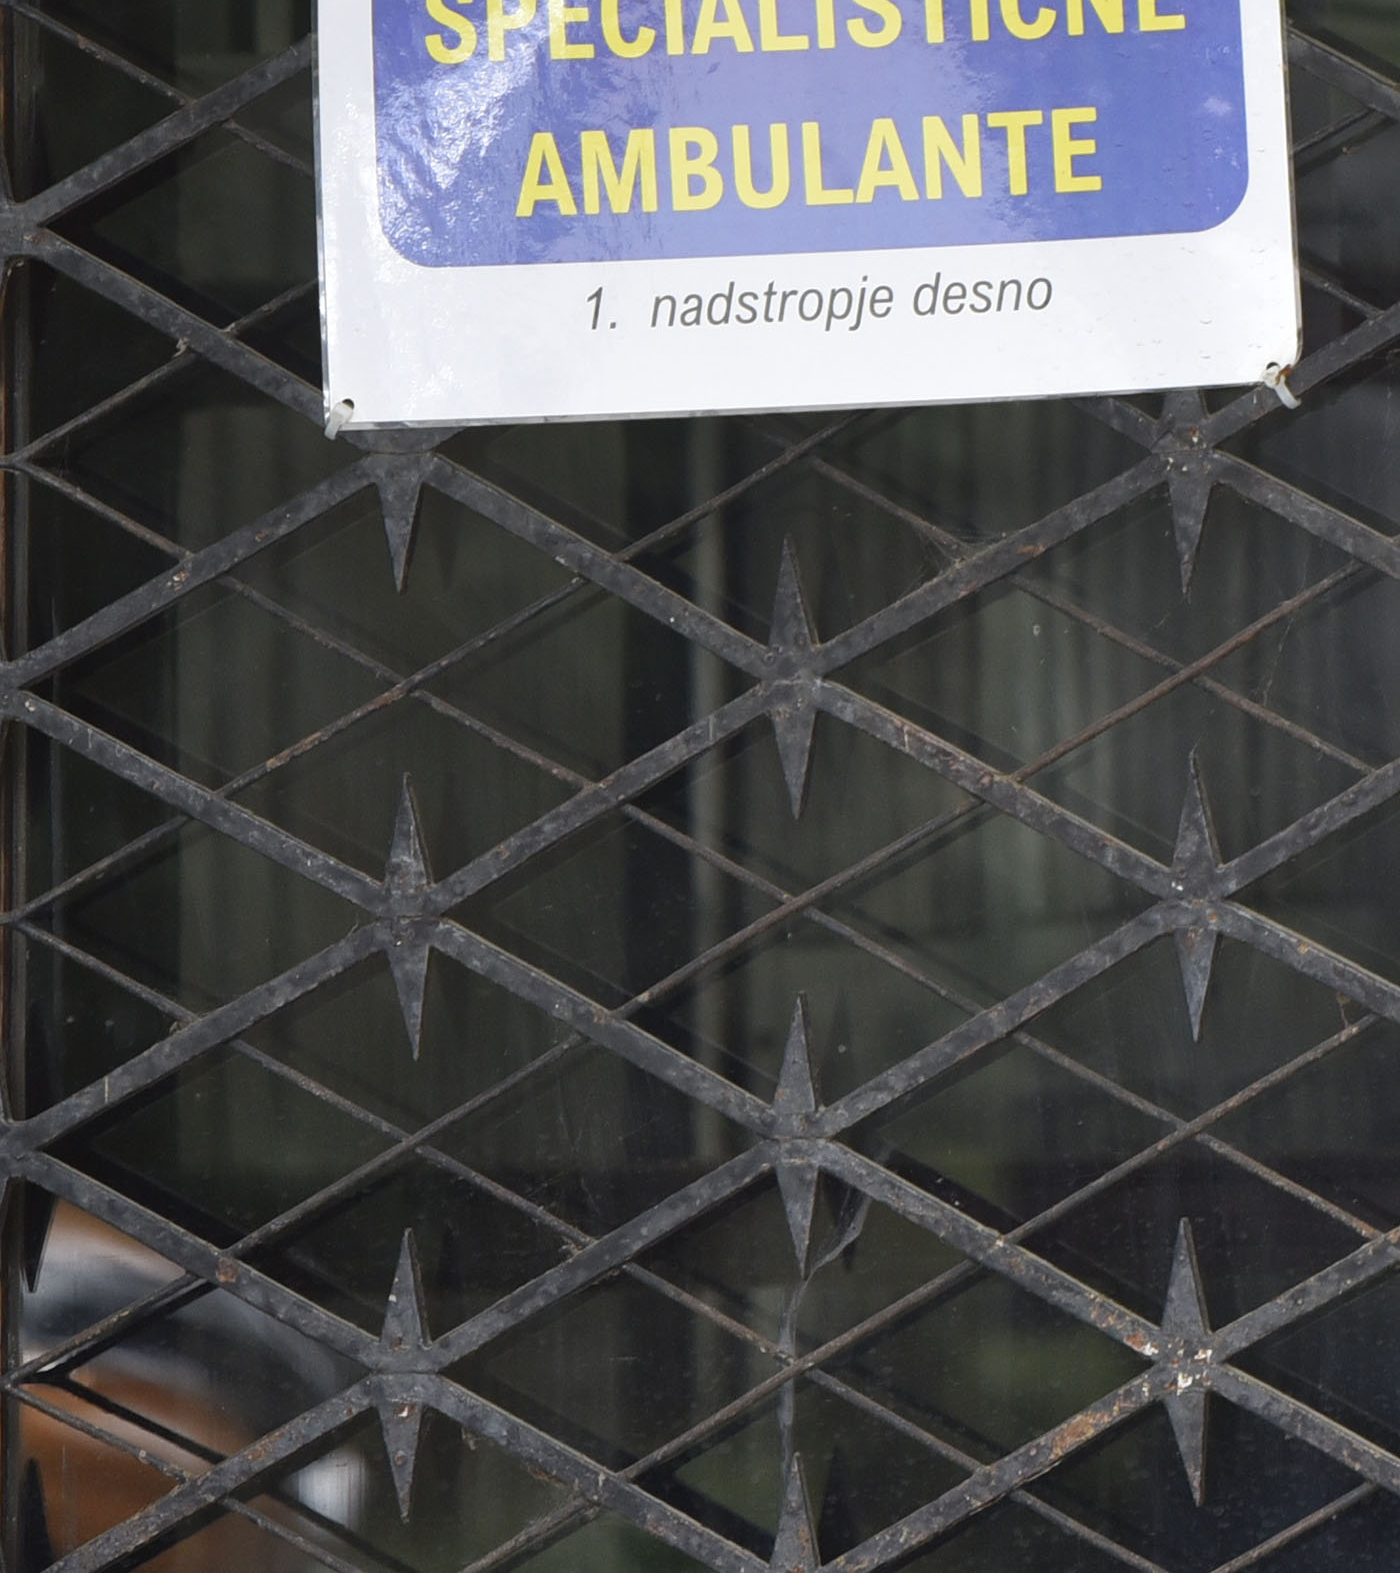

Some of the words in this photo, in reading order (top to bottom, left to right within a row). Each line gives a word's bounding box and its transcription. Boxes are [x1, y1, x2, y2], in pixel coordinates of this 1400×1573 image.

[515, 106, 1102, 217] AMBULANTE
[584, 287, 618, 330] 1.
[651, 275, 893, 331] nadstropje
[912, 276, 1053, 317] desno
